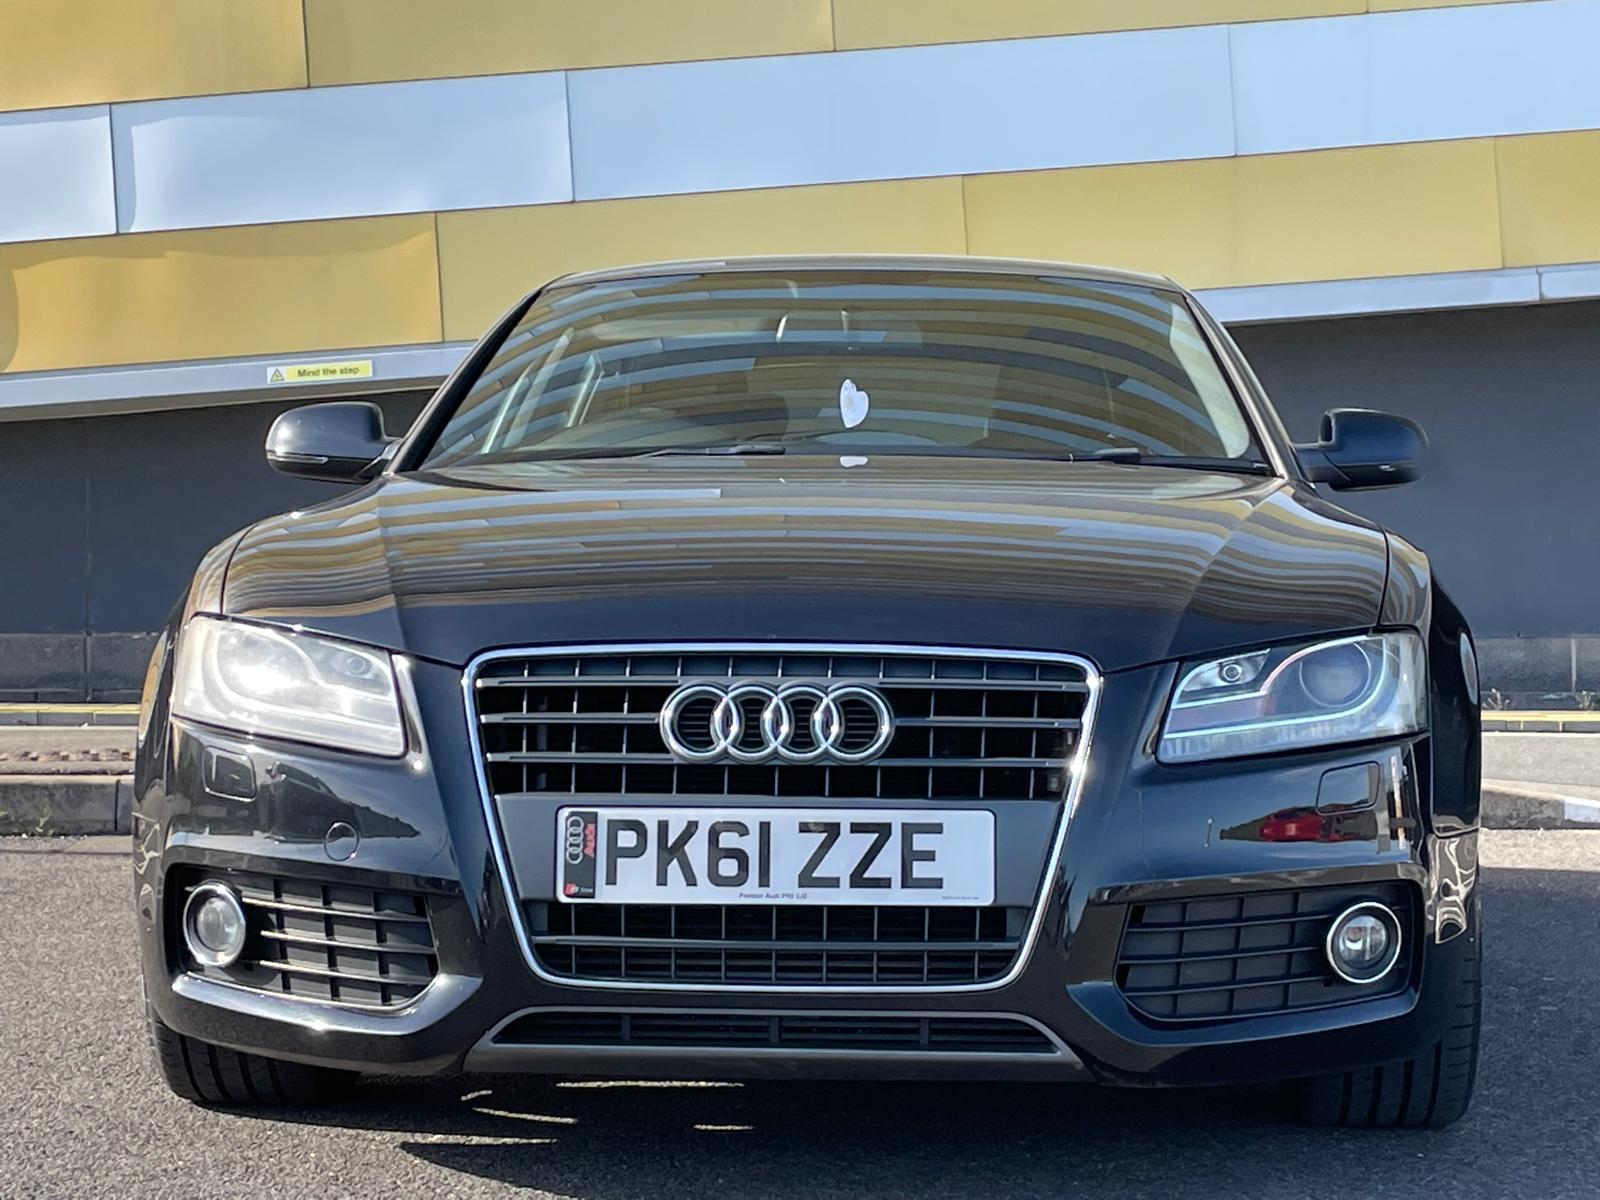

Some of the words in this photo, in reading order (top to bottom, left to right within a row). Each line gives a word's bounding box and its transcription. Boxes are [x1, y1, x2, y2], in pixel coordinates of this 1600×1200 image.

[298, 369, 320, 377] Mind
[323, 366, 337, 375] the
[340, 367, 360, 375] step
[605, 819, 771, 887] PK61
[797, 821, 943, 889] ZZE
